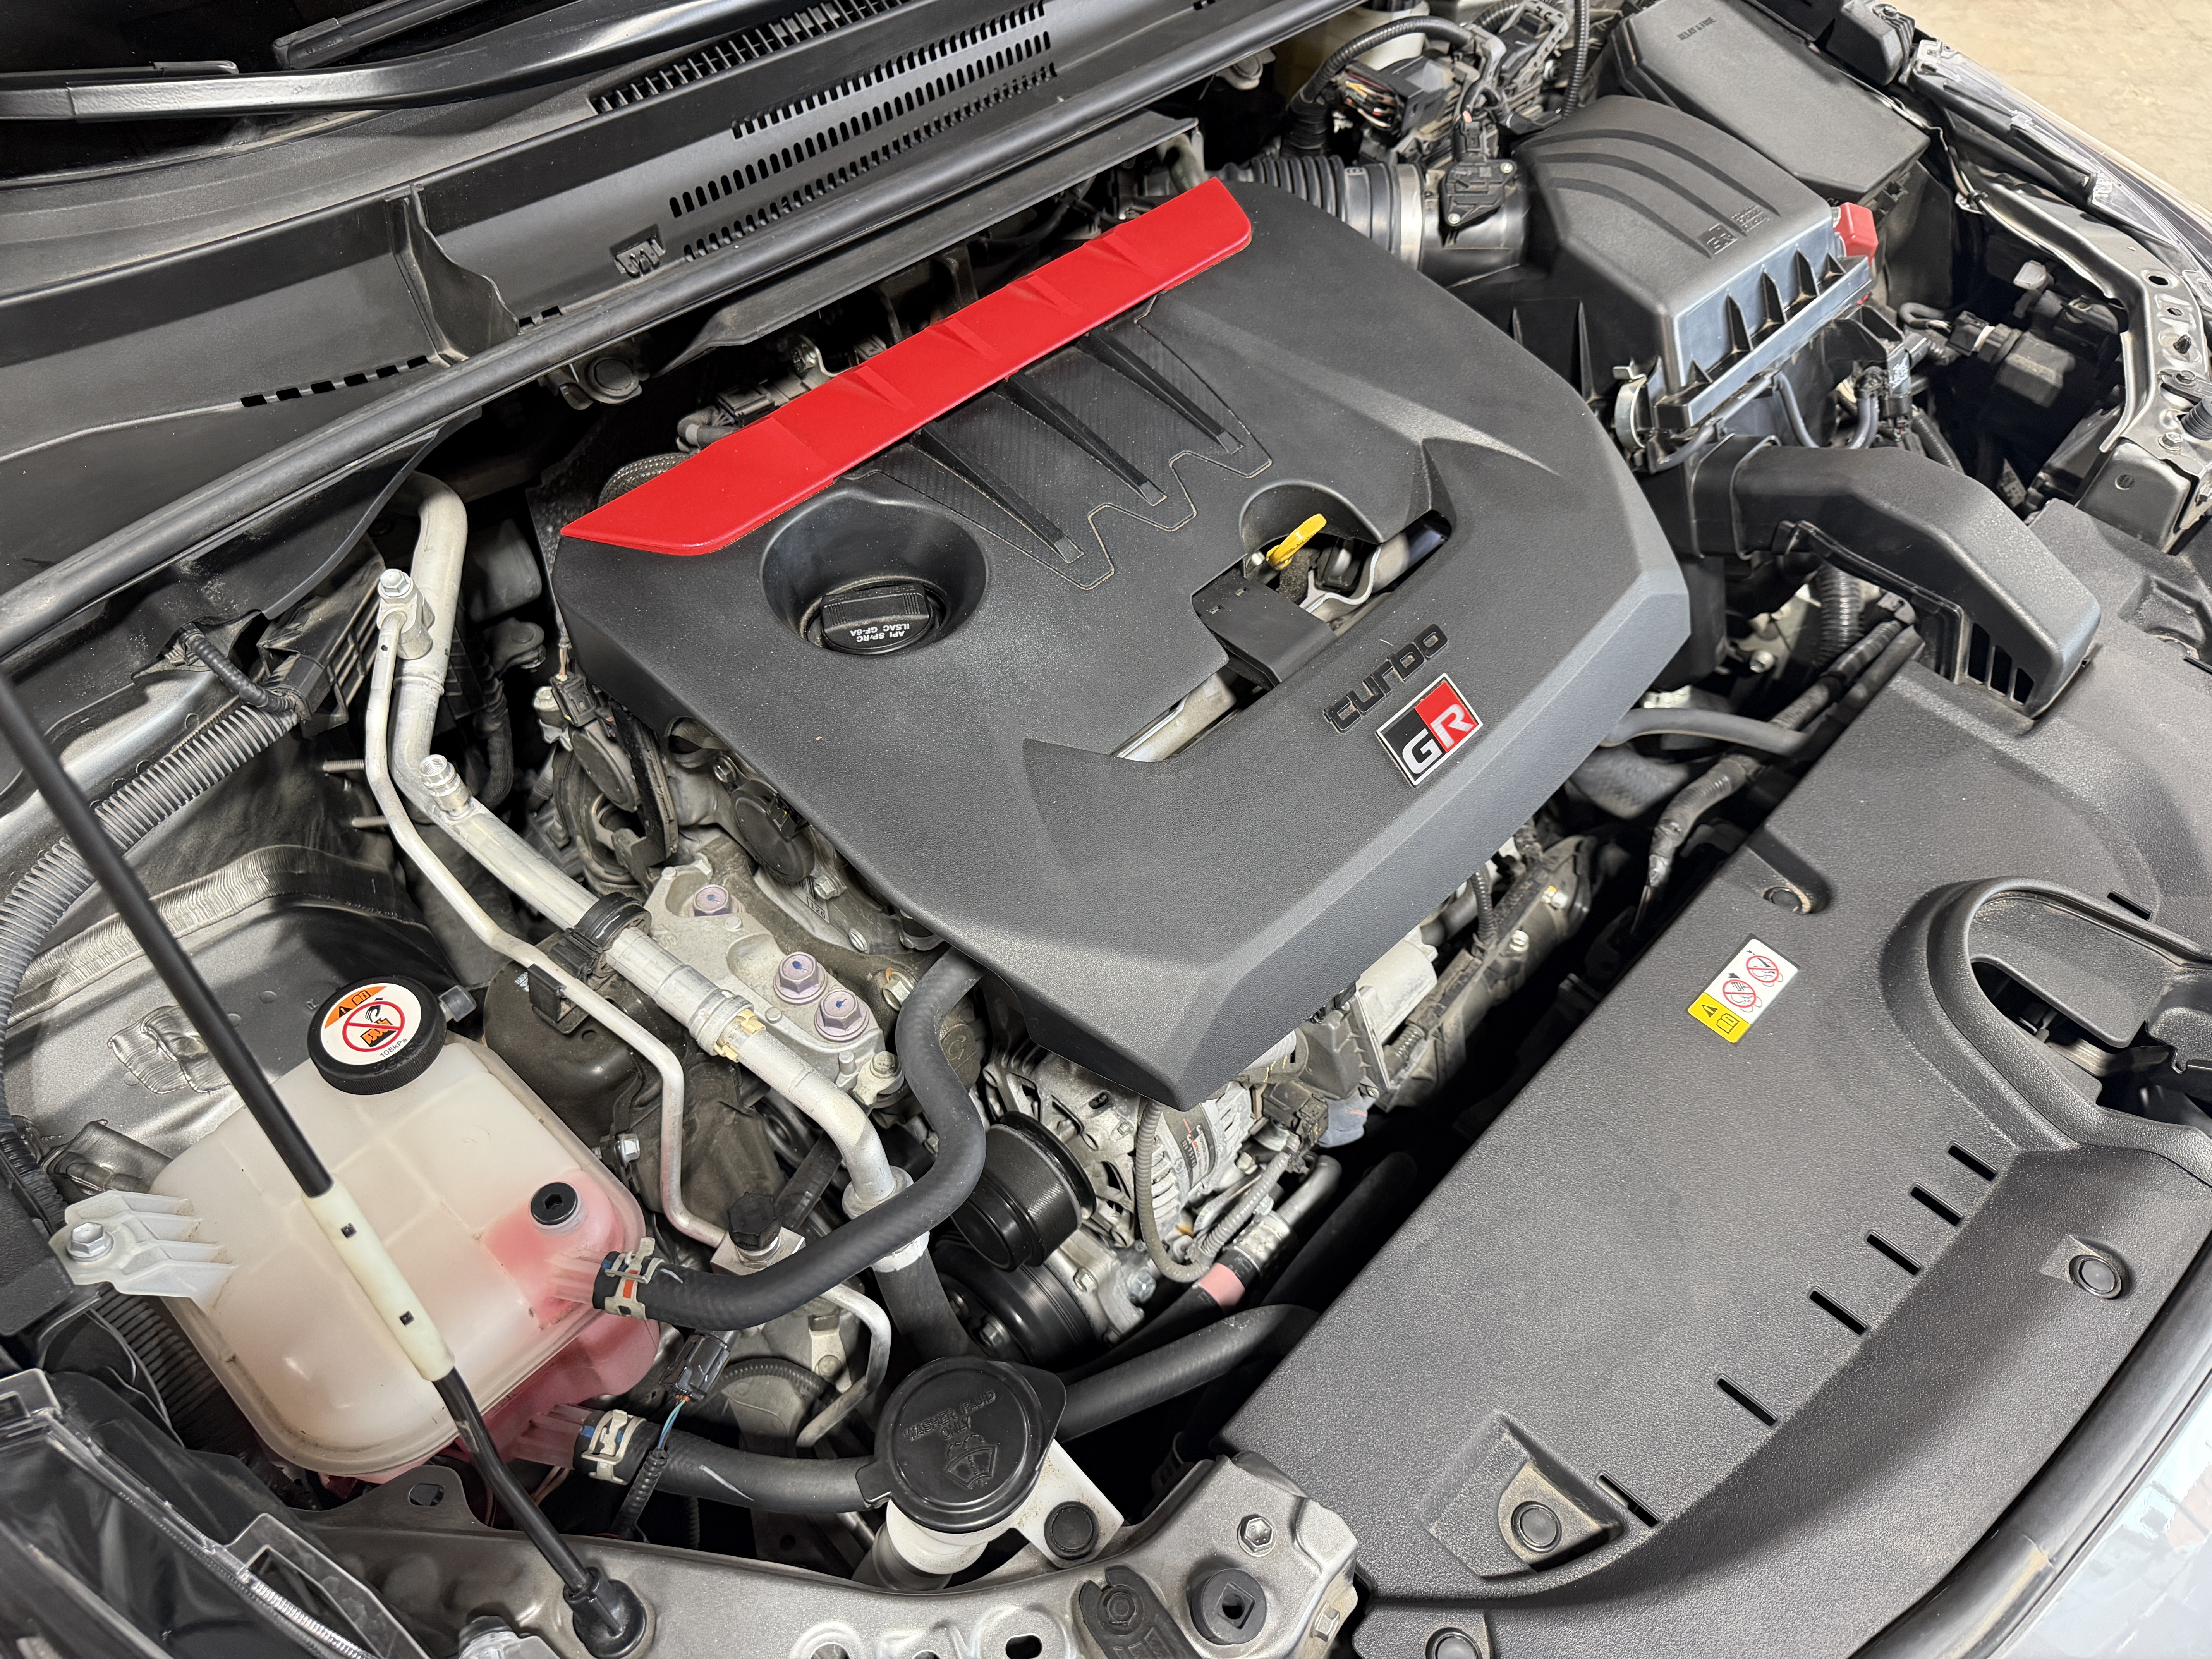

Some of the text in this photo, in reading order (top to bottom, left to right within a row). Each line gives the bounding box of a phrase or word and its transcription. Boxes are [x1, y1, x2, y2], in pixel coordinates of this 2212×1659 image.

[850, 623, 910, 637] ILSAC GF-6A
[856, 630, 905, 642] API SP/RC
[1401, 702, 1477, 775] GR
[809, 902, 826, 919] 120
[380, 1038, 408, 1058] 108kPa
[903, 1390, 996, 1442] WASHER FLUID
[940, 1415, 971, 1439] ONLY
